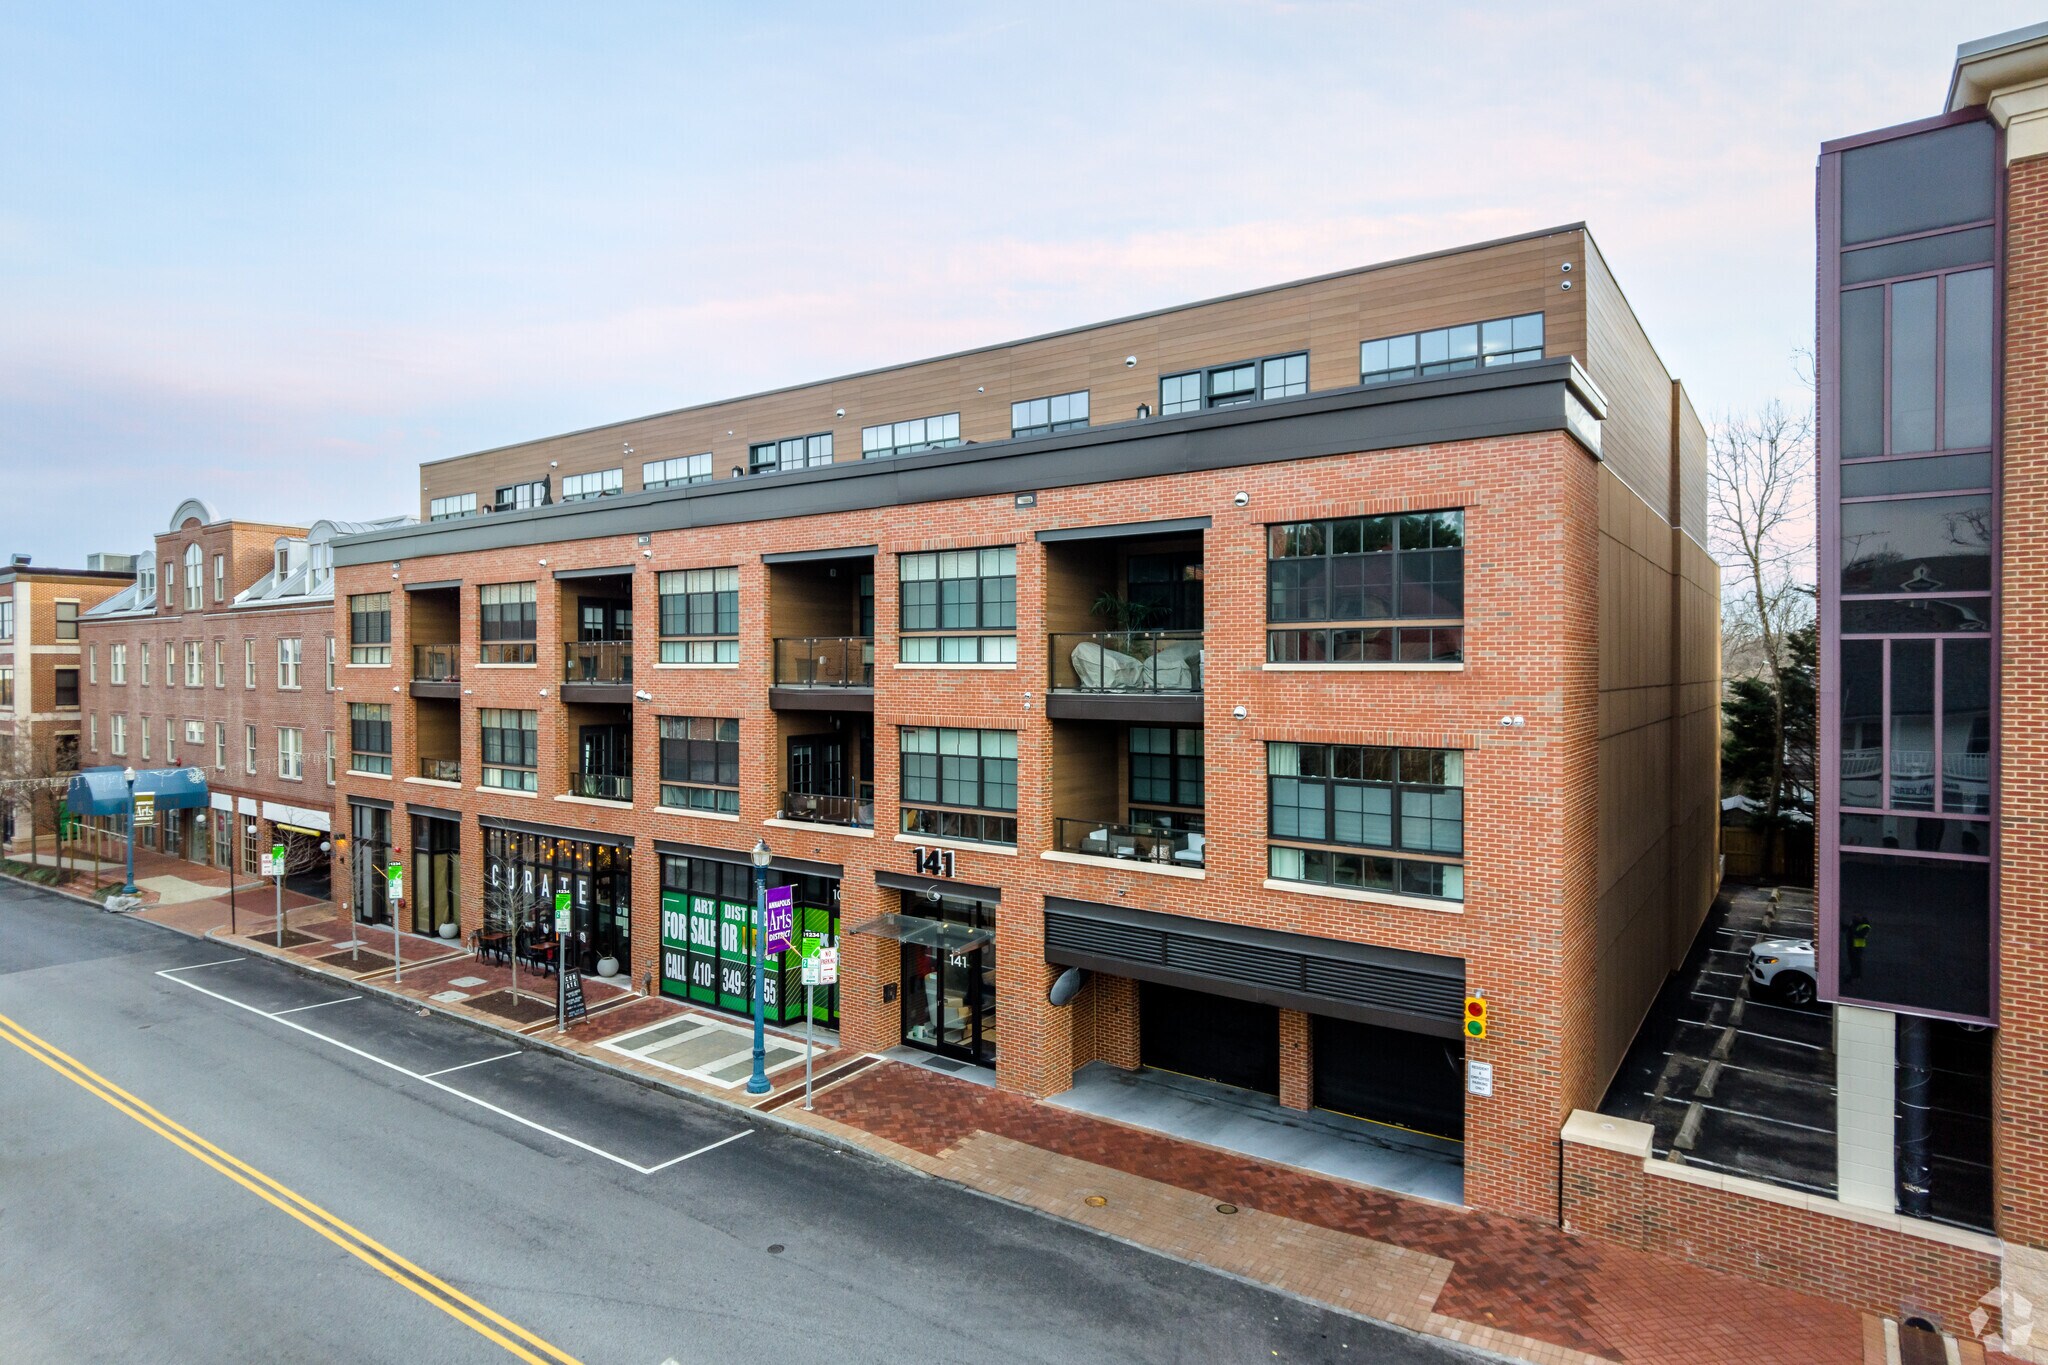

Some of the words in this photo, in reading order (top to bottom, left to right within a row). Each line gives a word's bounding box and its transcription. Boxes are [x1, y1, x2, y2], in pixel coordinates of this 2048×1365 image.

[912, 846, 955, 878] 141
[694, 898, 715, 915] ART
[664, 910, 687, 941] FOR
[690, 915, 716, 948] SALE
[721, 922, 738, 953] OR
[768, 908, 792, 932] Arts
[665, 952, 687, 981] CALL
[949, 954, 967, 968] 141
